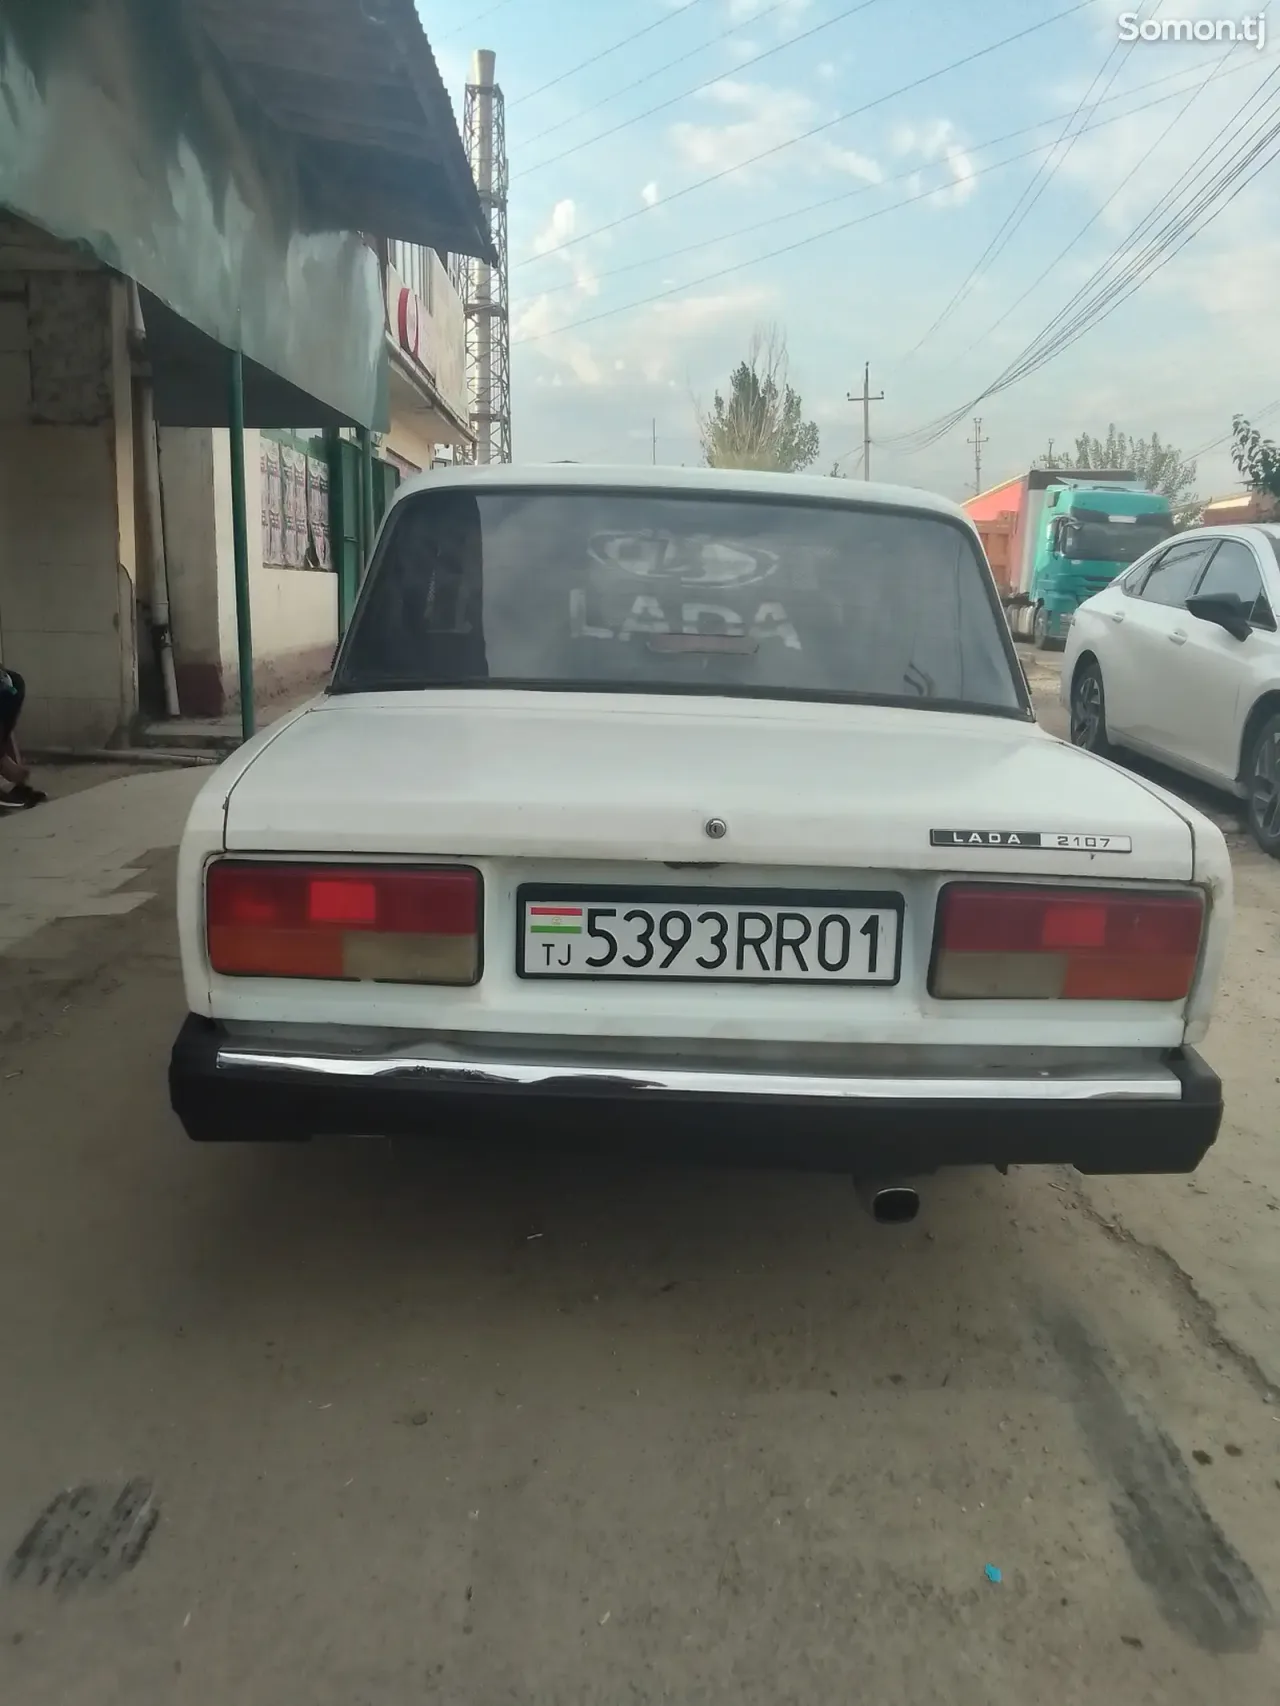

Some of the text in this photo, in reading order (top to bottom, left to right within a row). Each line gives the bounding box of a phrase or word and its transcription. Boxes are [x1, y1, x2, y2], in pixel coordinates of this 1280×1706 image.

[569, 588, 802, 650] LADA
[953, 831, 1110, 848] LADA 2107
[541, 908, 880, 973] TJ 5393RR01
